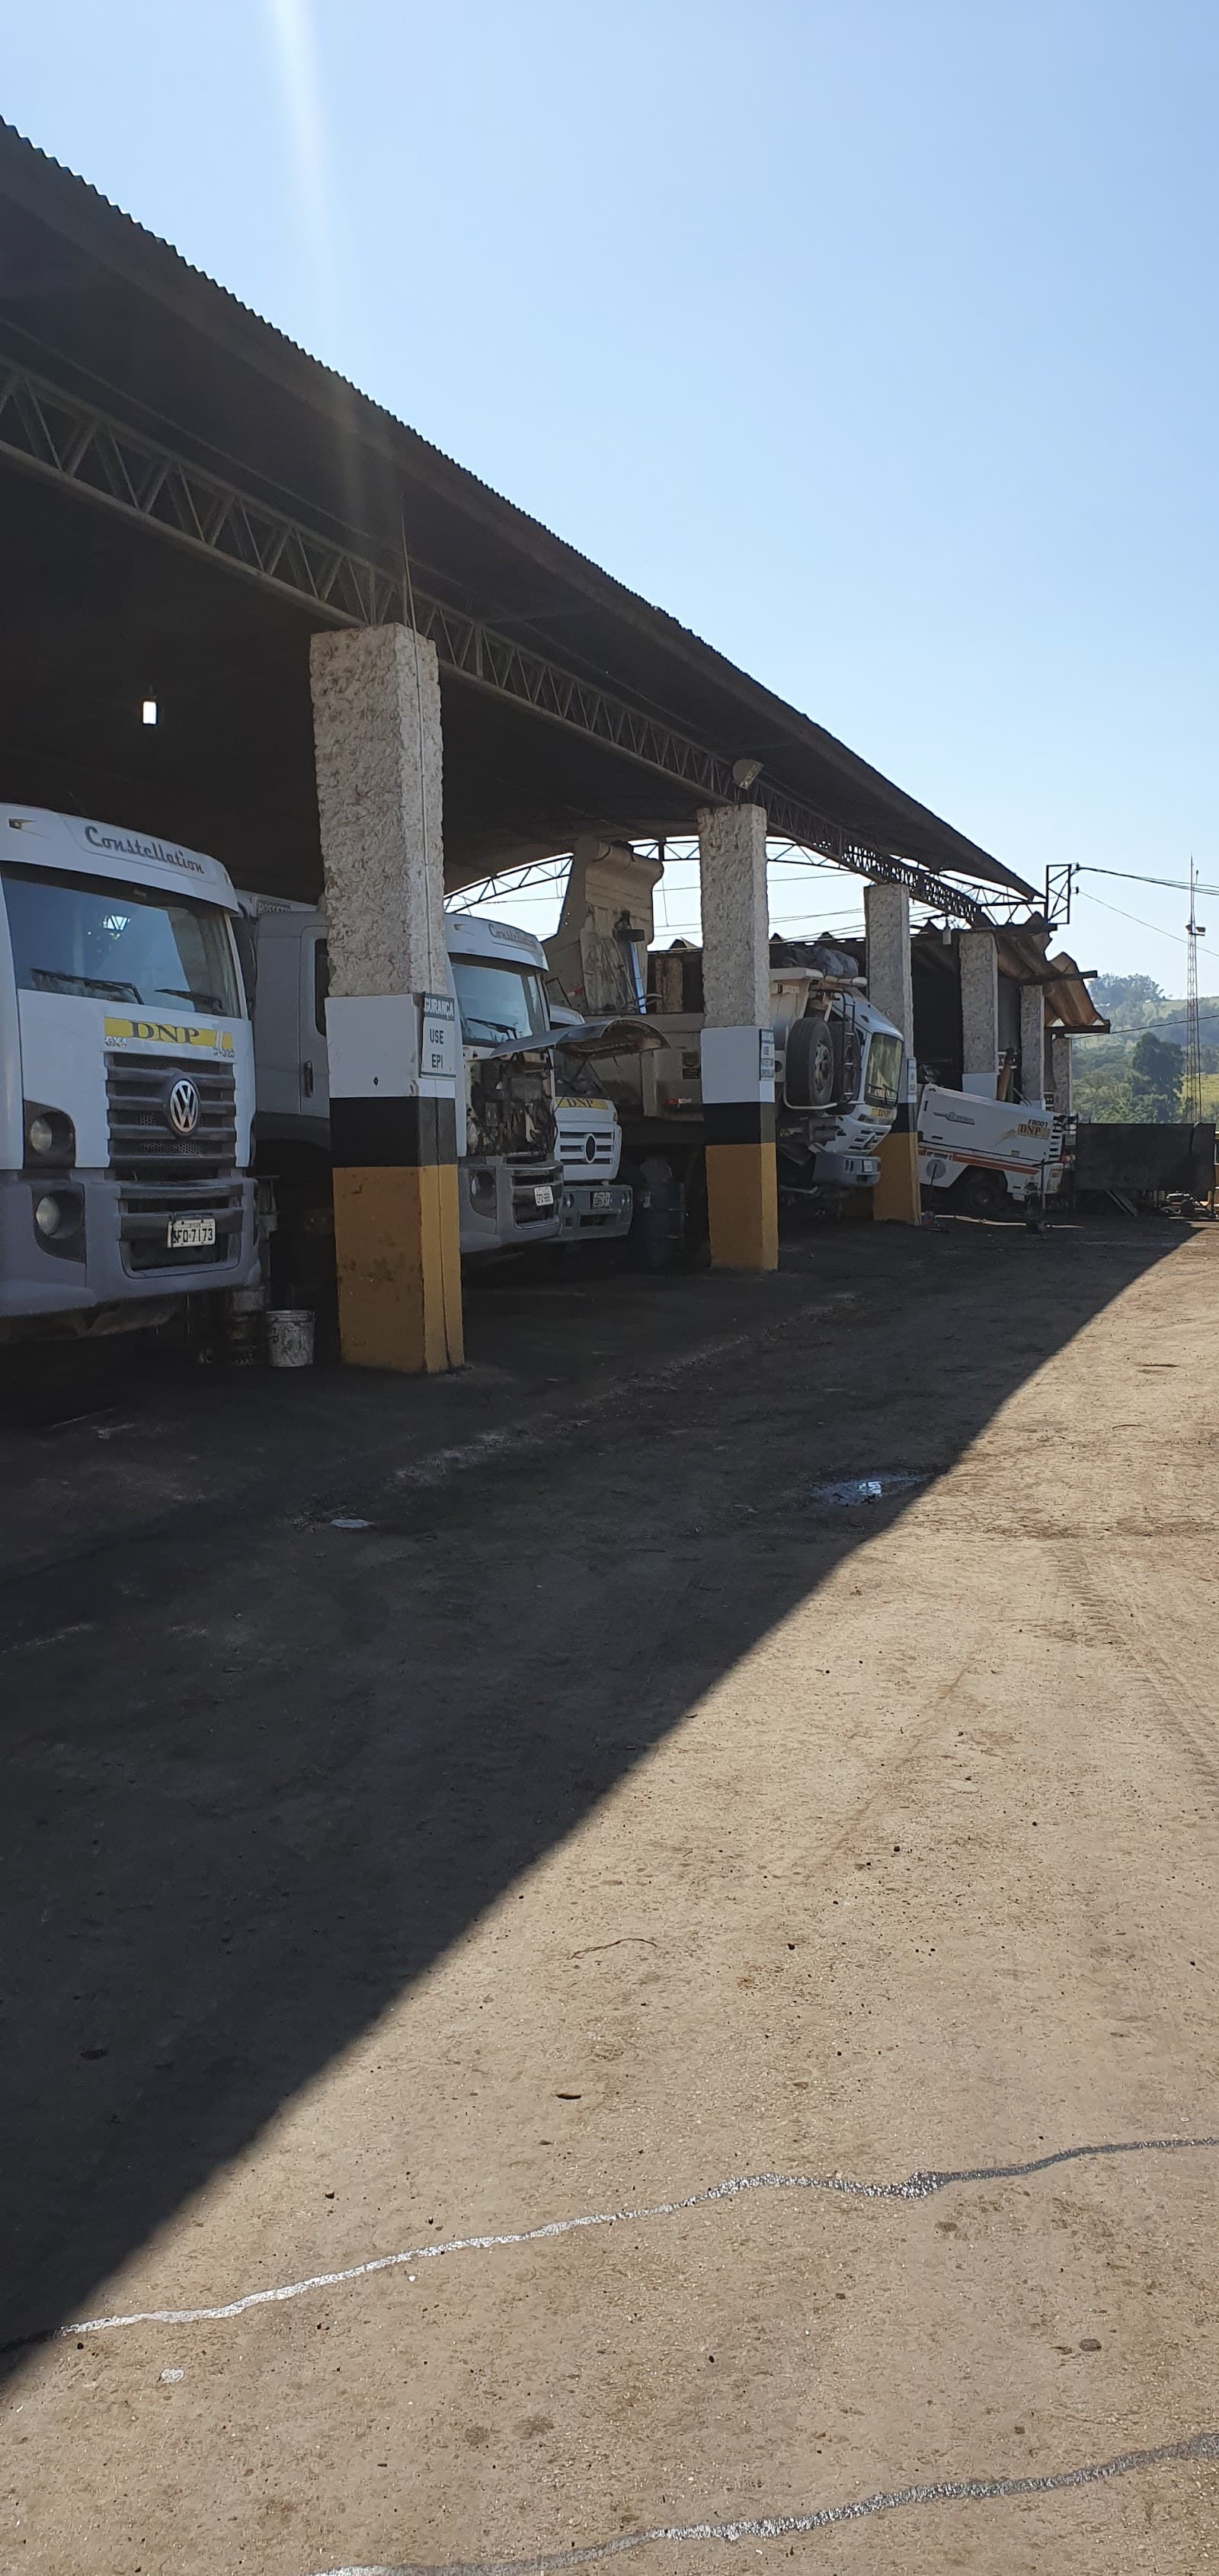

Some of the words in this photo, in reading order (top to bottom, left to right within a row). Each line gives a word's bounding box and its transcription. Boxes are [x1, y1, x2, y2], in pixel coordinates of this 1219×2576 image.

[85, 825, 205, 875] Constellation
[129, 1021, 200, 1044] DNP
[430, 1029, 444, 1045] USE
[431, 1054, 443, 1068] EPI
[566, 1098, 594, 1108] DNP
